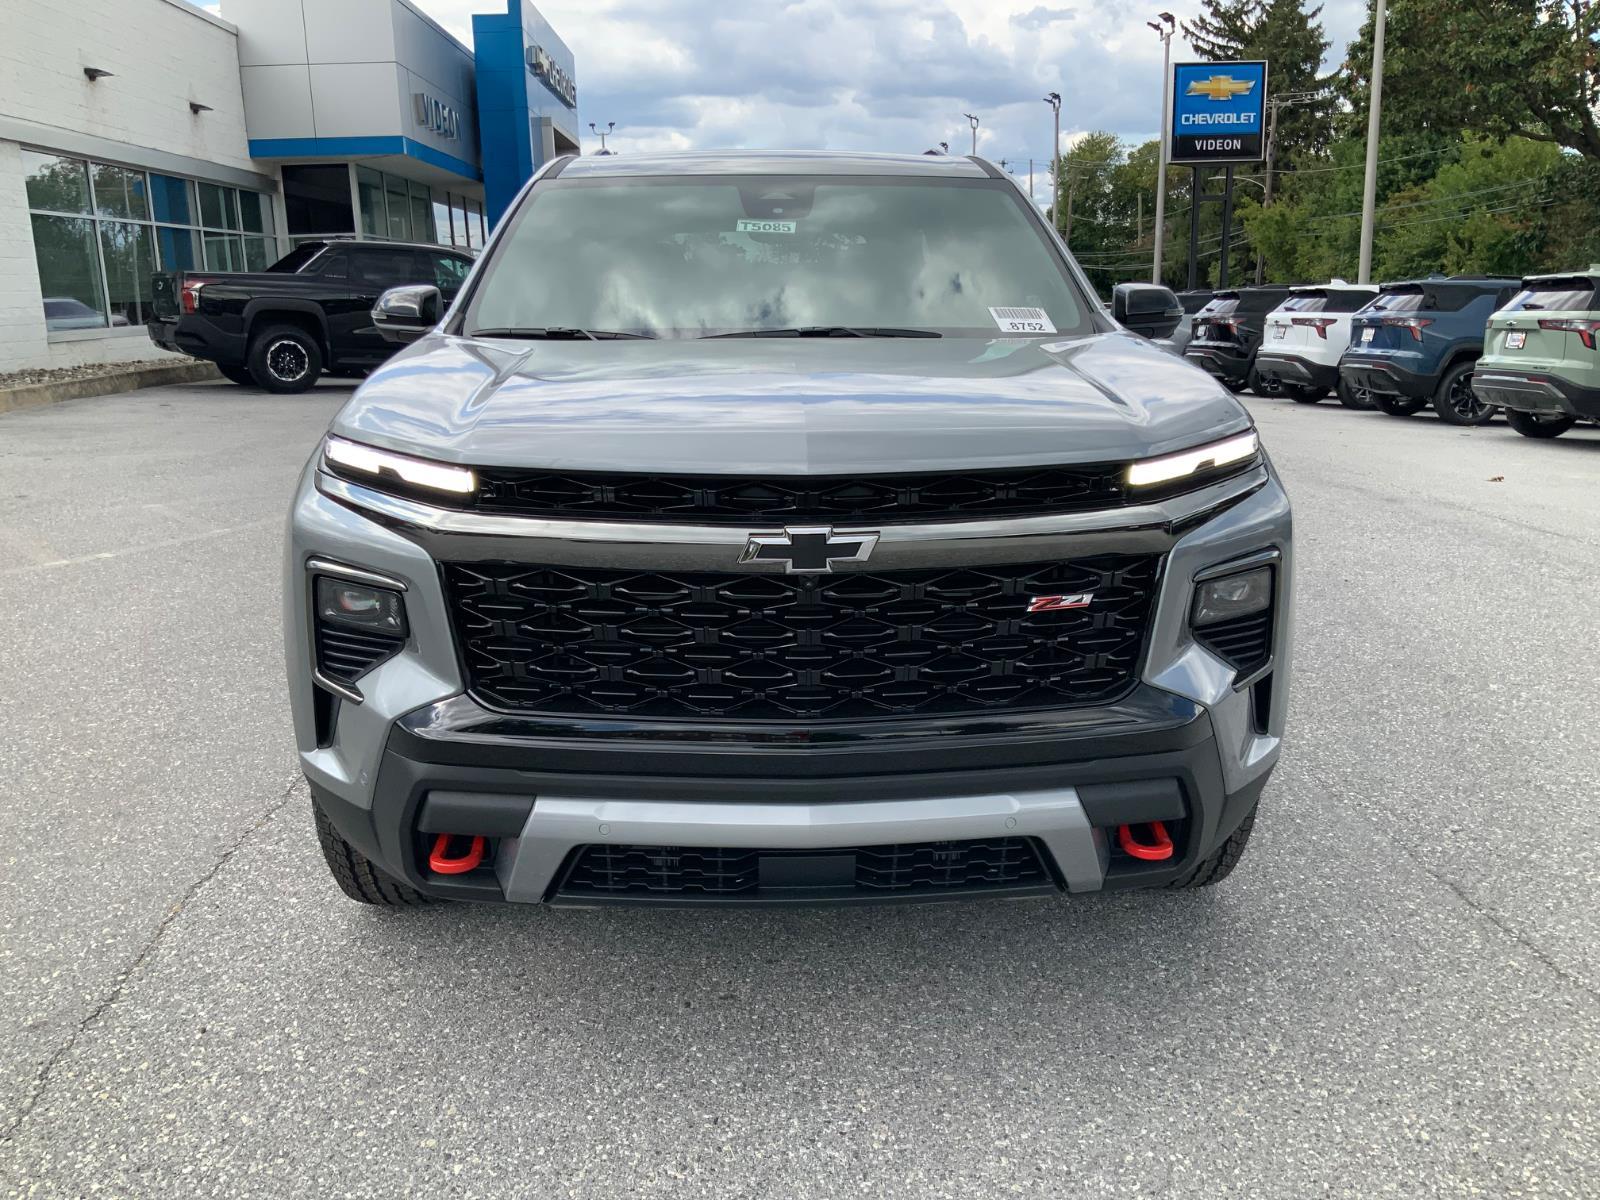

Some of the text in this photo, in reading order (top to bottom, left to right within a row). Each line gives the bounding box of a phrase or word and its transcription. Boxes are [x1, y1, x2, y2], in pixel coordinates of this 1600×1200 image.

[415, 93, 462, 141] VIDEON
[1181, 112, 1257, 125] CHEVROLET
[1195, 139, 1241, 151] VIDEON
[741, 221, 792, 232] T5085
[1009, 322, 1046, 331] 8752
